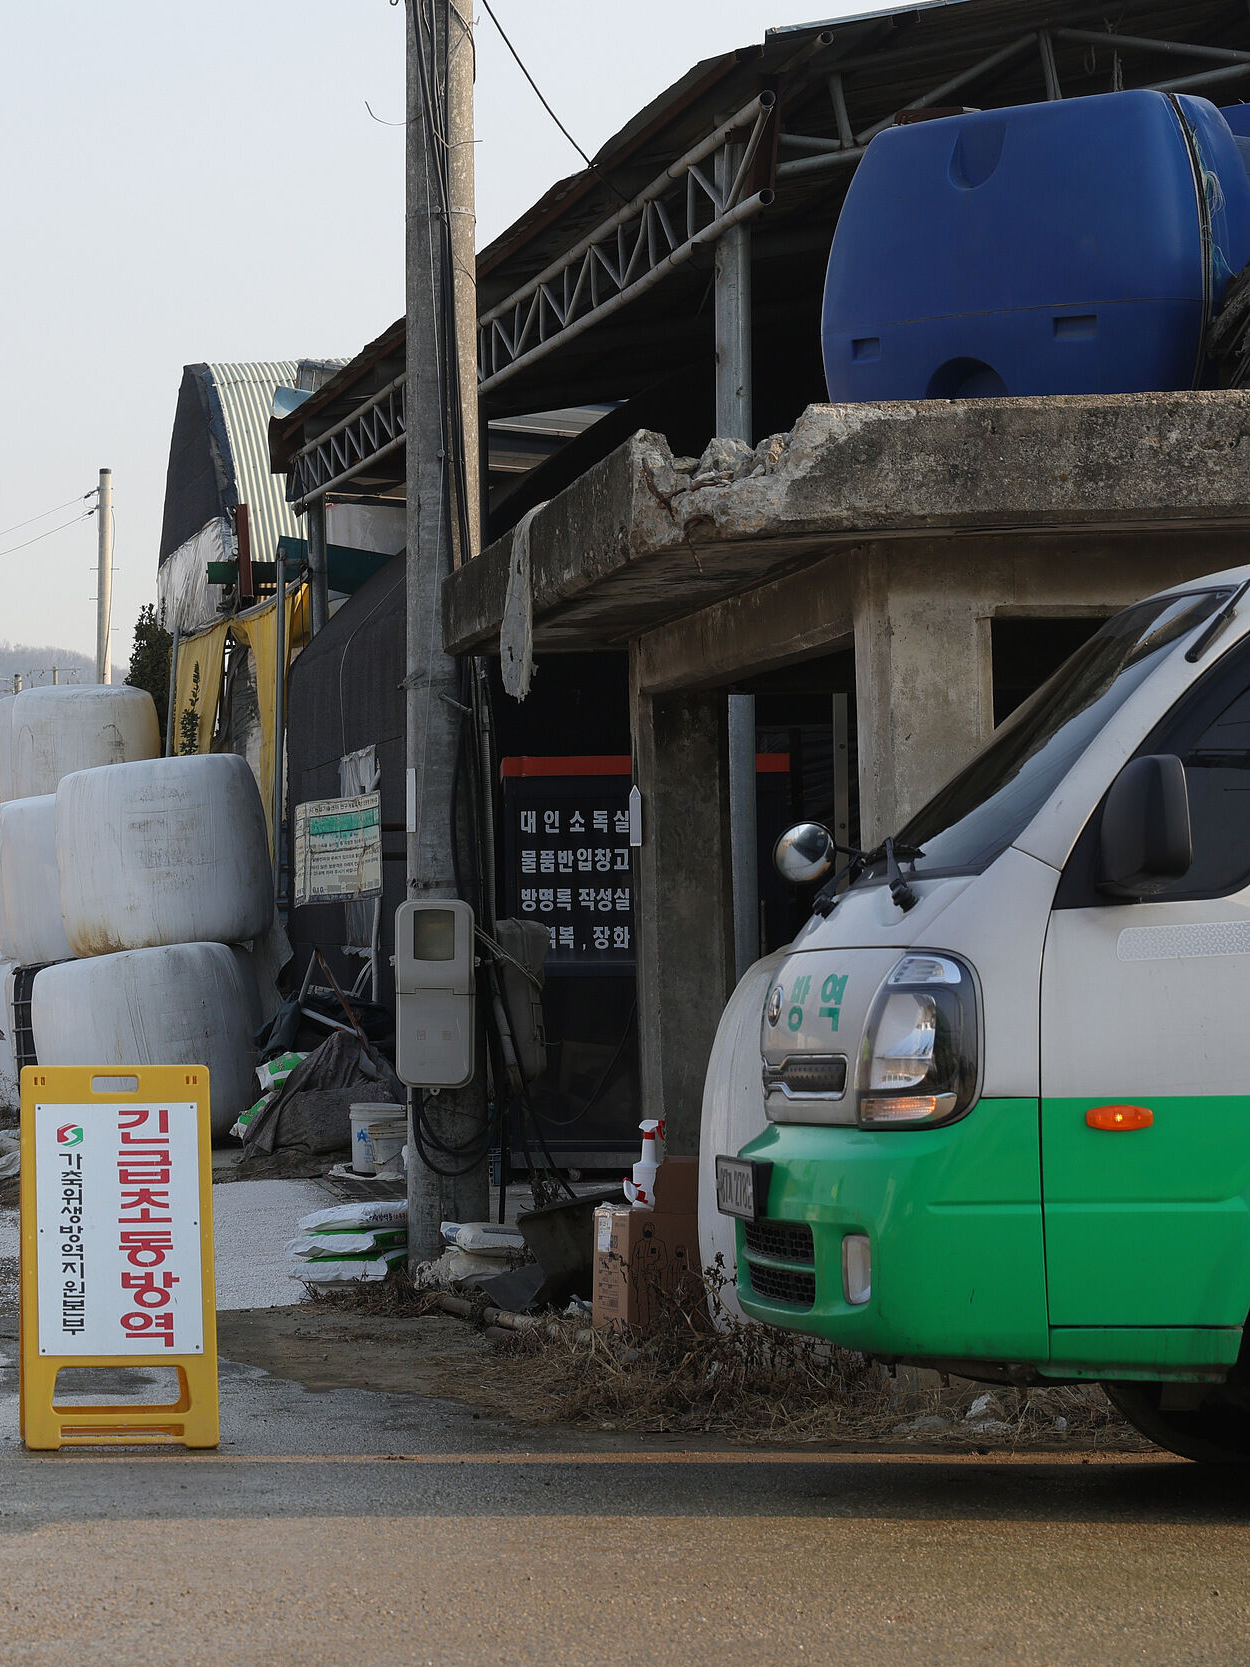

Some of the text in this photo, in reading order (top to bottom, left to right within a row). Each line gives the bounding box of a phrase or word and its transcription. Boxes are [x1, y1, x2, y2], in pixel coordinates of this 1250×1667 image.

[521, 848, 630, 873] 물품반입창고
[521, 888, 630, 912] 방명록 작성실
[593, 926, 631, 950] 장화
[787, 973, 849, 1033] 방역
[58, 1153, 87, 1336] 가축위생방역지원본부
[117, 1109, 180, 1348] 긴급초동방역
